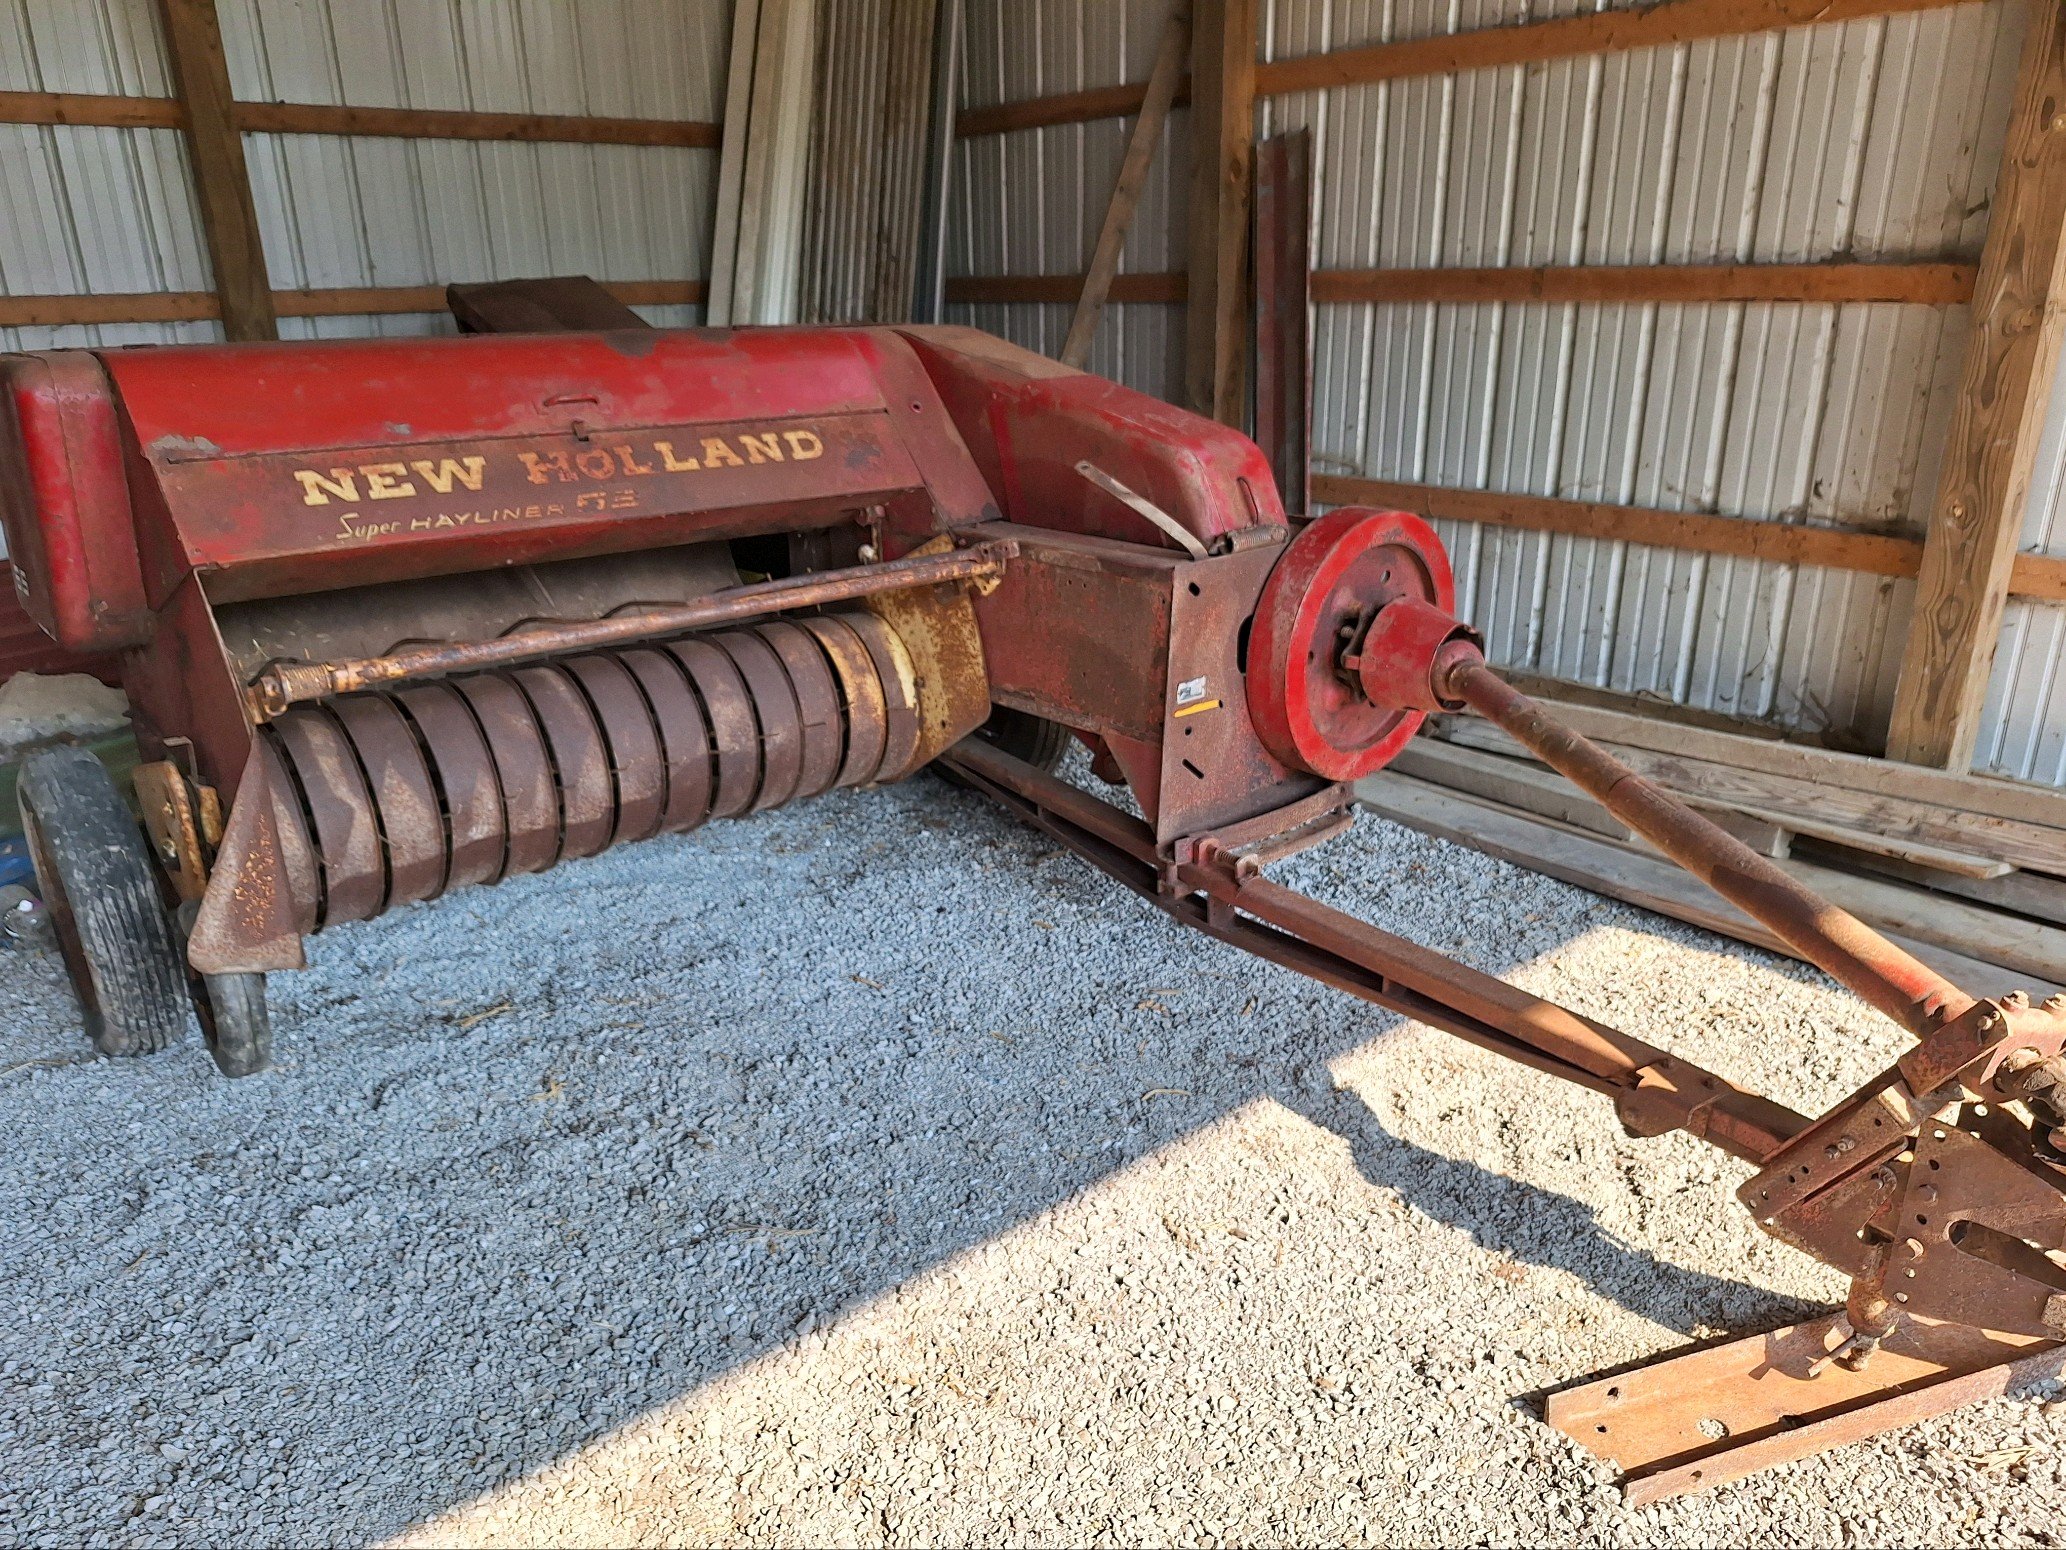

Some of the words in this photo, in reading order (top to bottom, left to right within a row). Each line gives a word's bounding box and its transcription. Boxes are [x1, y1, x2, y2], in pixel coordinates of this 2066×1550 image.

[293, 455, 486, 506] NEW
[517, 429, 824, 485] HOLLAND
[336, 512, 402, 542] Super
[410, 503, 566, 531] HAYLINER
